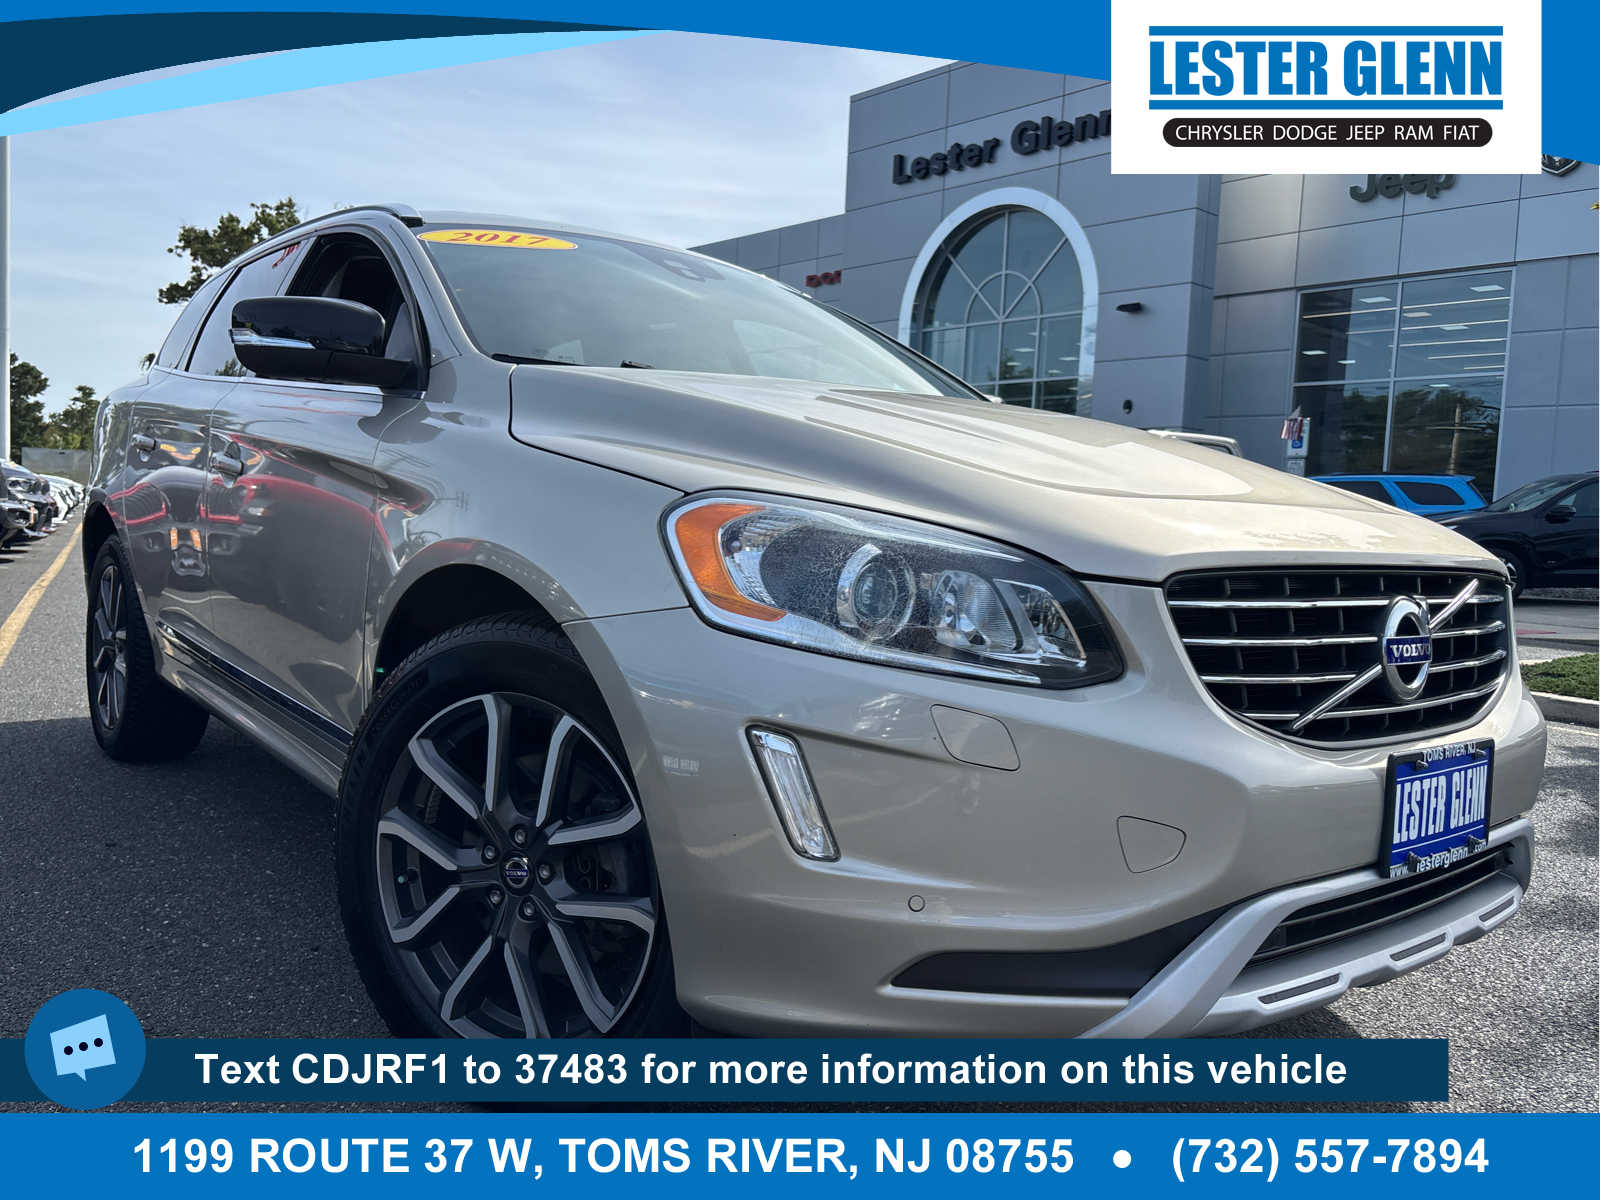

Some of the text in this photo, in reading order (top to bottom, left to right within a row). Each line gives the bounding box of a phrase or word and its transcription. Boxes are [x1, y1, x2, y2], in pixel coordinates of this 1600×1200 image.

[893, 137, 1001, 185] Lester
[1350, 174, 1456, 203] Jeep
[448, 231, 549, 245] 2017
[1390, 643, 1431, 658] VOLVO
[1422, 747, 1444, 762] TOMS
[1467, 741, 1477, 755] NJ
[1392, 764, 1488, 845] LESTER GLENN
